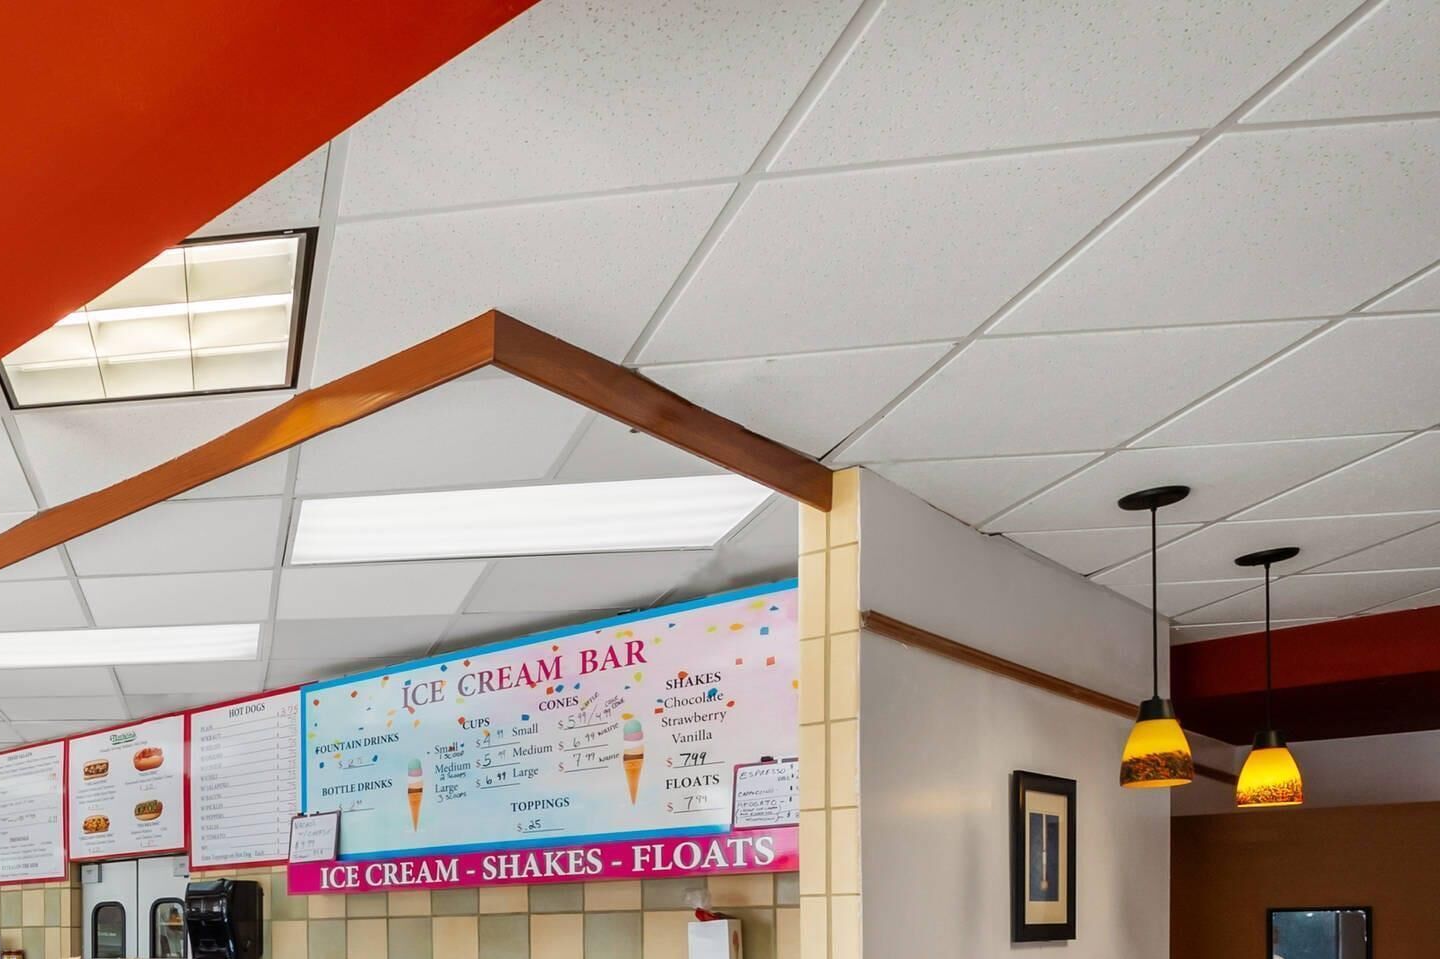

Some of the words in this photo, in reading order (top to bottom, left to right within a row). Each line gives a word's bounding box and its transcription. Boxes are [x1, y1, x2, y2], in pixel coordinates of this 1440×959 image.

[401, 680, 445, 708] ICE
[457, 655, 563, 697] CREAM
[579, 640, 648, 675] BAR
[666, 671, 722, 690] SHAKES
[539, 696, 579, 711] CONES
[664, 692, 724, 709] Chocolate
[229, 707, 244, 718] HOT
[245, 702, 265, 715] DOGS
[462, 717, 490, 730] CUPS
[661, 711, 726, 727] Strawberry
[512, 724, 538, 736] Small
[672, 730, 712, 744] Vanilla
[315, 740, 362, 755] FOUNTAIN
[364, 733, 399, 747] DRINKS
[434, 741, 458, 754] Small
[512, 744, 553, 757] Medium
[435, 761, 471, 774] Medium
[512, 768, 539, 780] Large
[322, 783, 357, 797] BOTTLE
[357, 779, 393, 792] DRINKS
[435, 783, 459, 795] Large
[666, 774, 720, 789] FLOATS
[511, 797, 570, 813] TOPPINGS
[321, 866, 360, 890] ICE
[365, 858, 460, 886] CREAM
[482, 848, 603, 881] SHAKES
[631, 835, 776, 873] FLOATS
